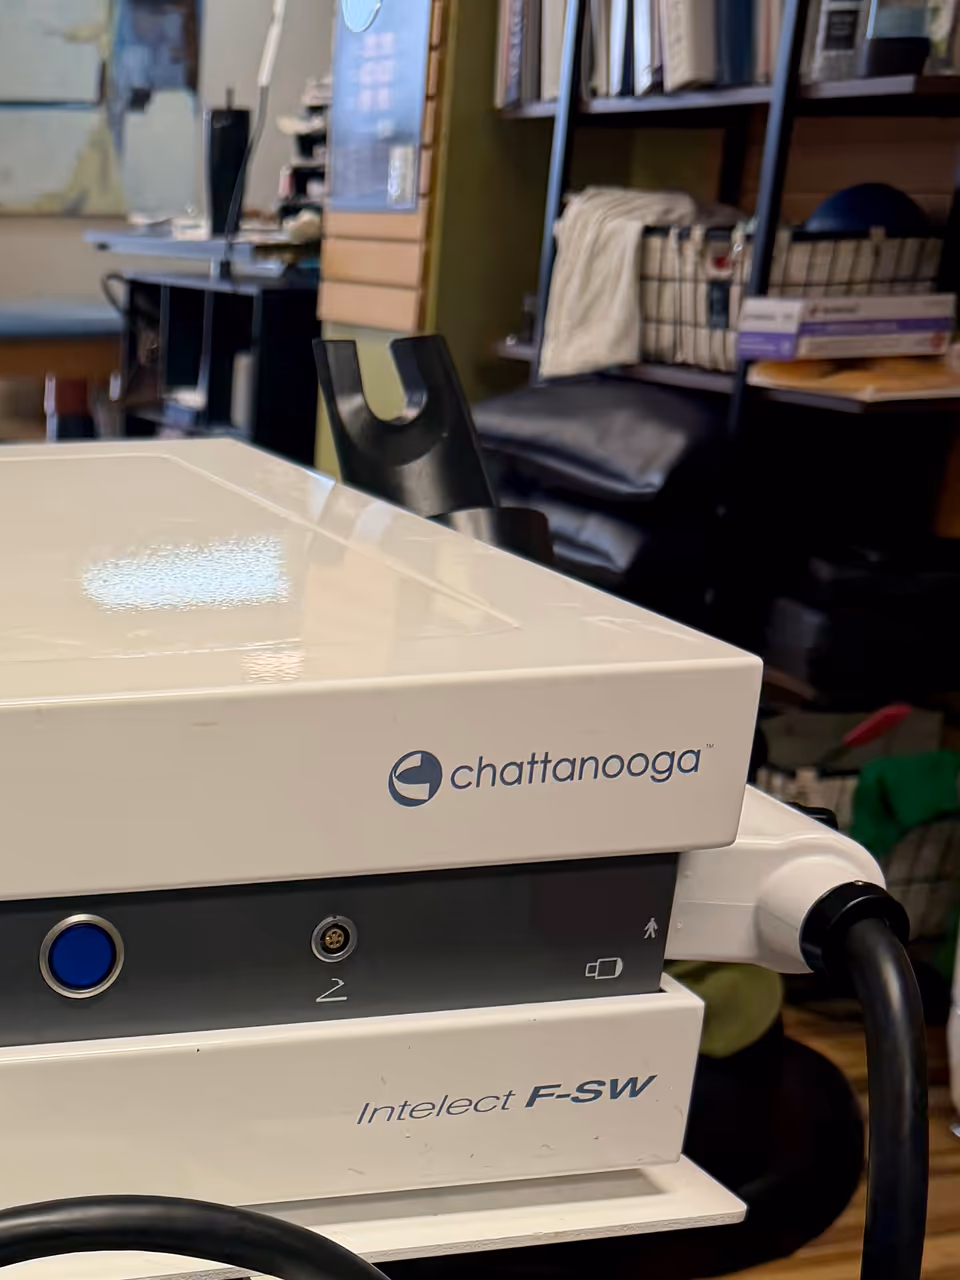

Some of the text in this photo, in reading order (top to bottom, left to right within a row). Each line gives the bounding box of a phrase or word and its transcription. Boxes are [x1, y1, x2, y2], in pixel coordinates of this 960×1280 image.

[450, 749, 702, 790] chattanooga
[356, 1074, 658, 1125] Intelect F-SW
